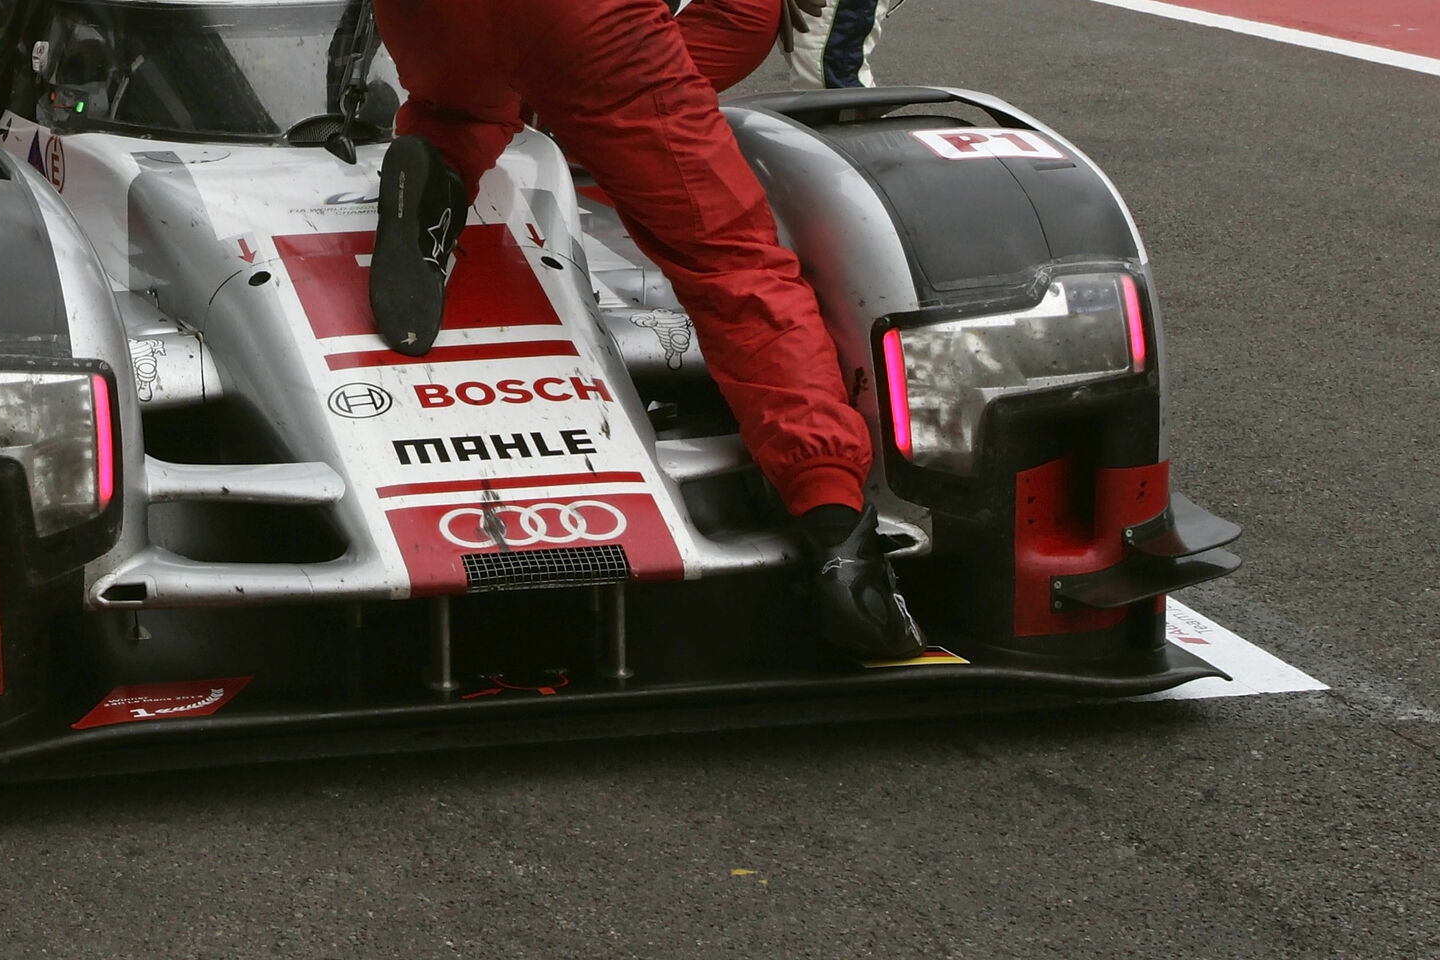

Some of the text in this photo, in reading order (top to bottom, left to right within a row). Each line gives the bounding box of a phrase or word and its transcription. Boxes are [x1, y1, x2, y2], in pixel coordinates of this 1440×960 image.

[936, 132, 1039, 152] P1
[414, 376, 613, 408] BOSCH
[392, 429, 597, 465] MAHLE
